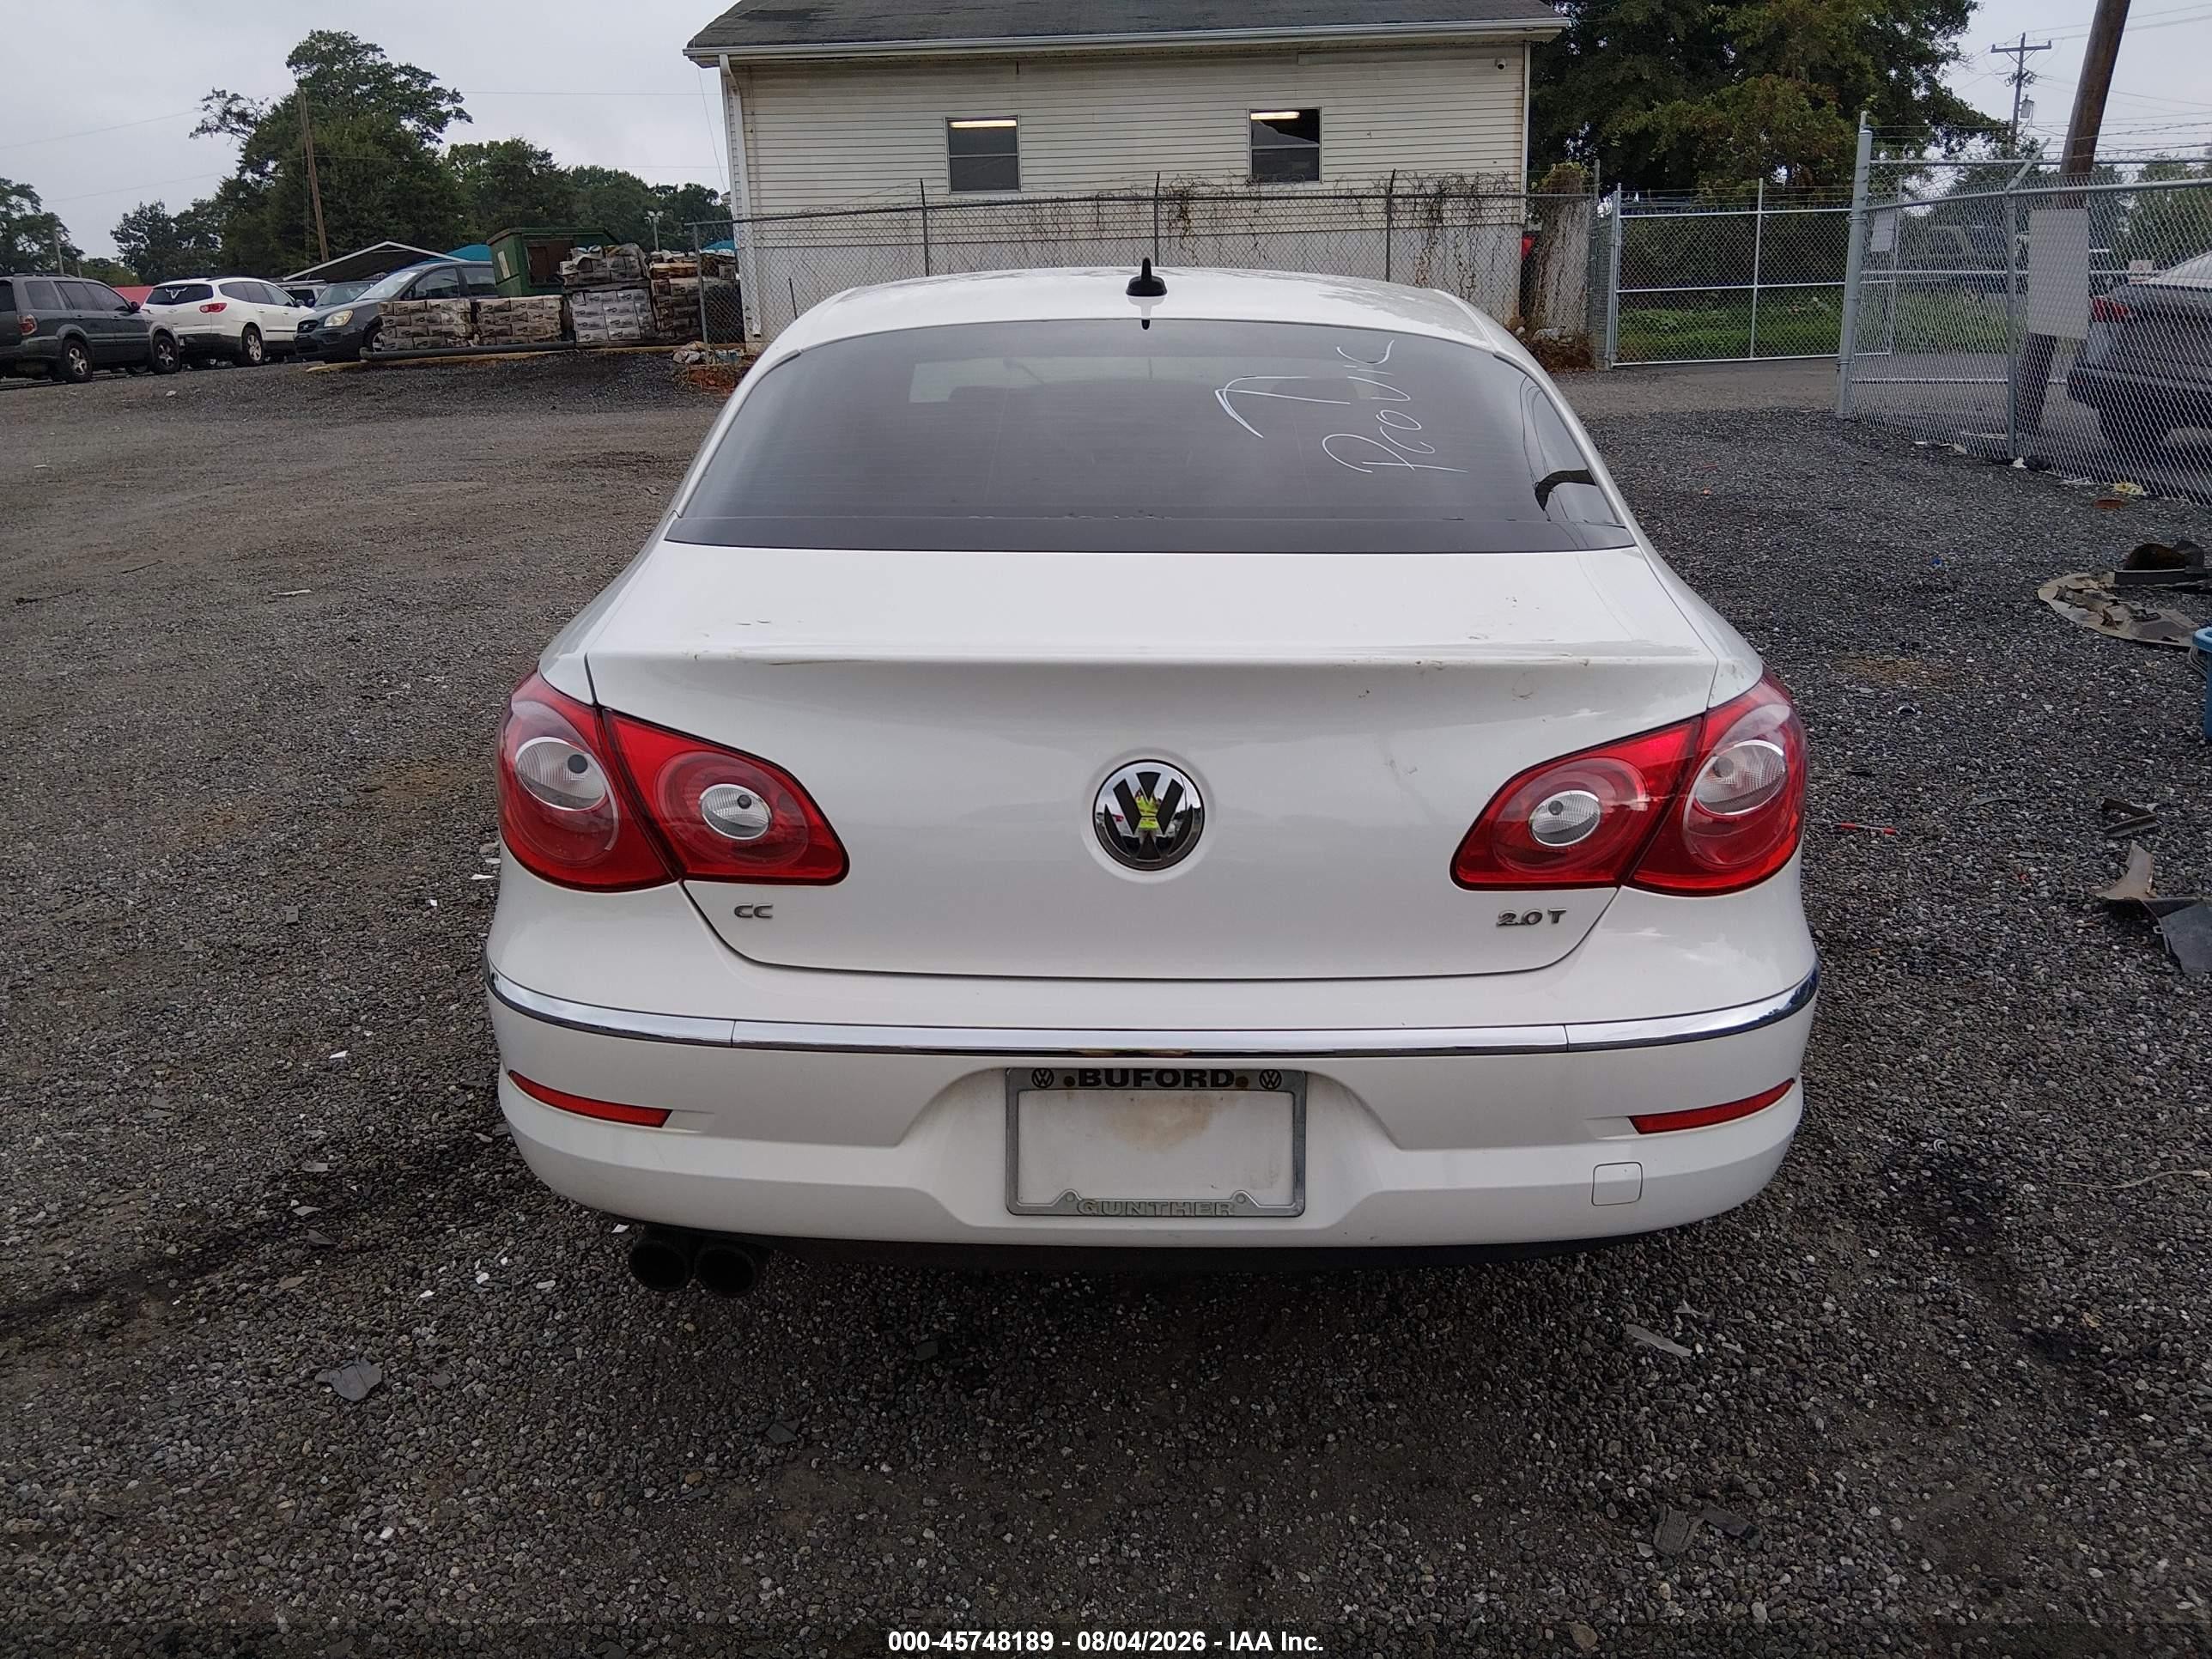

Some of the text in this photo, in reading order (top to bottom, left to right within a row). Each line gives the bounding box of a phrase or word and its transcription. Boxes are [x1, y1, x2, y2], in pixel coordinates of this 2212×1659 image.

[734, 904, 773, 918] CC
[1078, 1068, 1235, 1088] BUFORD
[1077, 1200, 1236, 1217] GUNTHER
